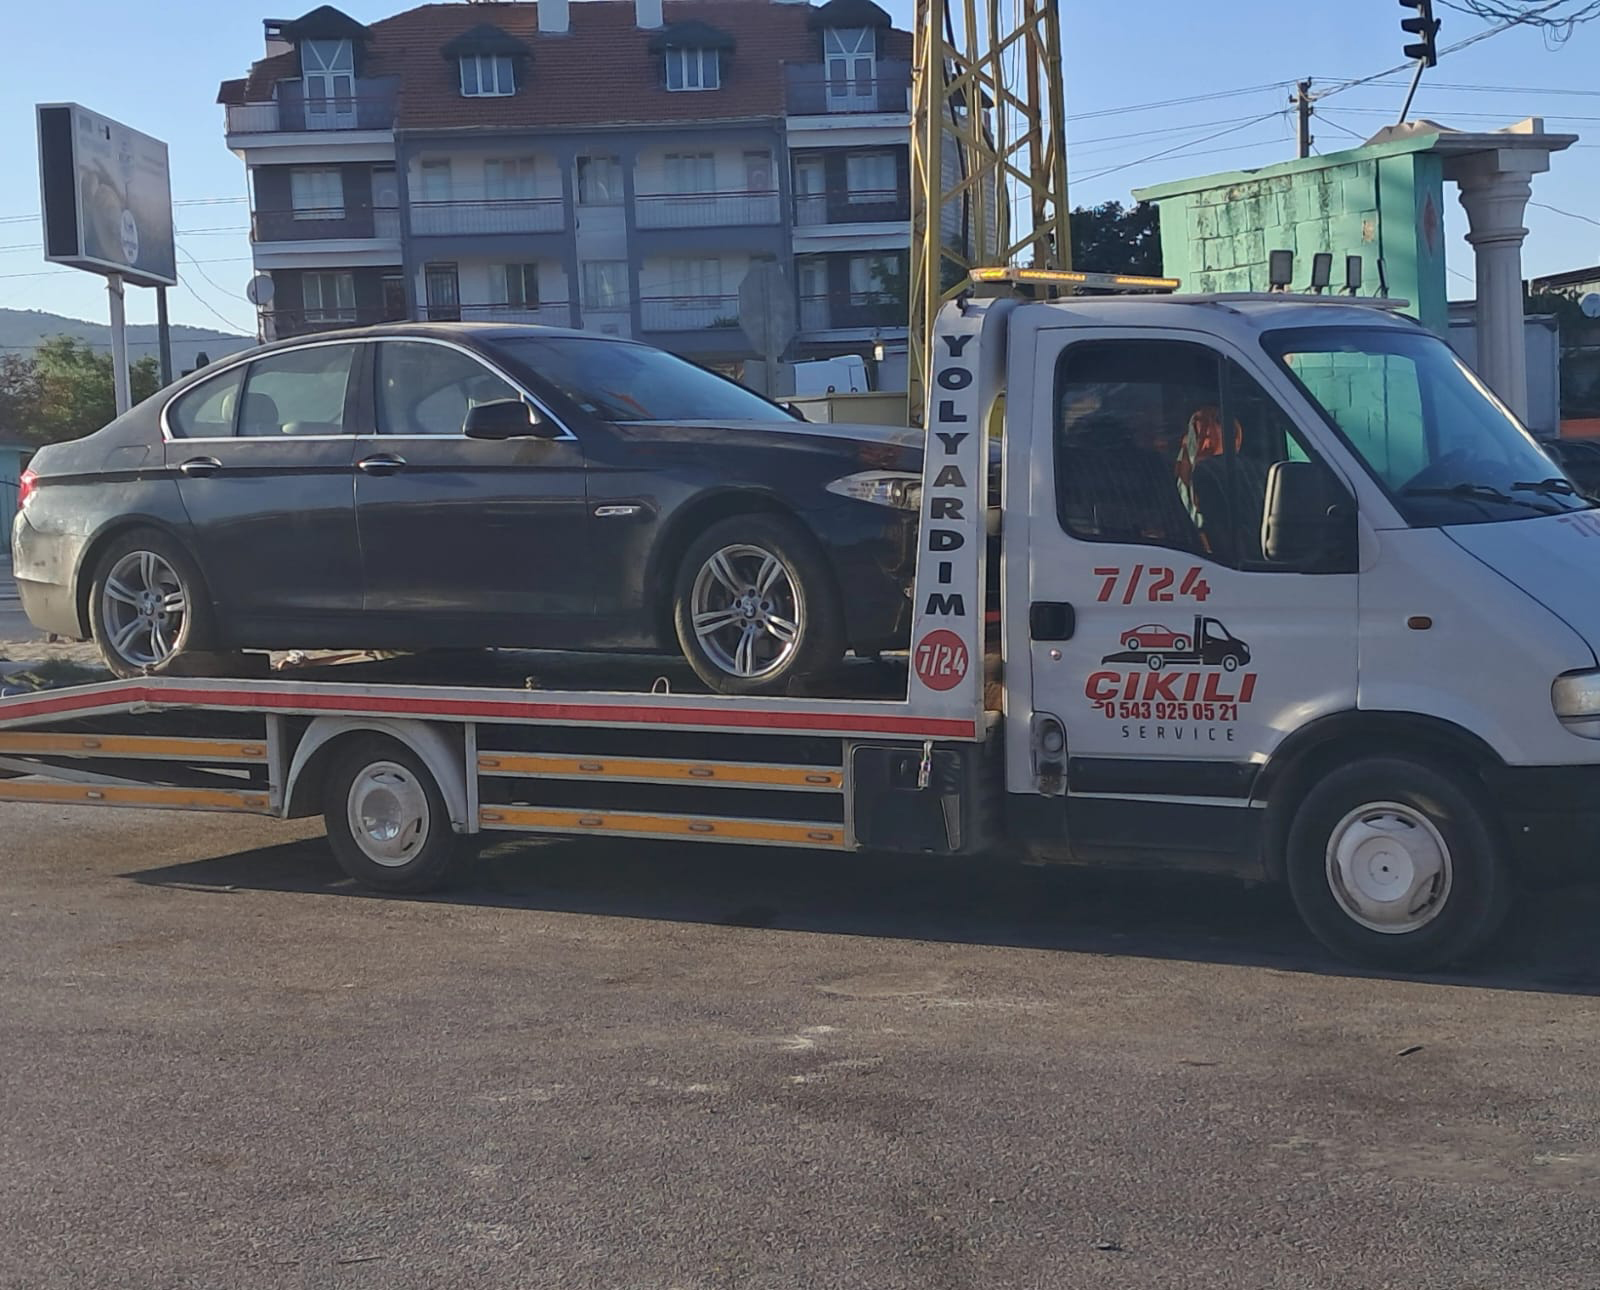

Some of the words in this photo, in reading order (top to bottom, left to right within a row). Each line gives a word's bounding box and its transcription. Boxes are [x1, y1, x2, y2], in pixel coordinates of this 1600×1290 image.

[925, 335, 974, 616] YOLYARDIM
[1094, 565, 1211, 605] 7/24
[919, 643, 966, 676] 7/24
[1105, 702, 1115, 719] 0
[1119, 702, 1151, 720] 543
[1155, 702, 1188, 720] 925
[1192, 703, 1215, 721] 05
[1219, 703, 1238, 721] 21
[1121, 725, 1235, 742] SERVICE
